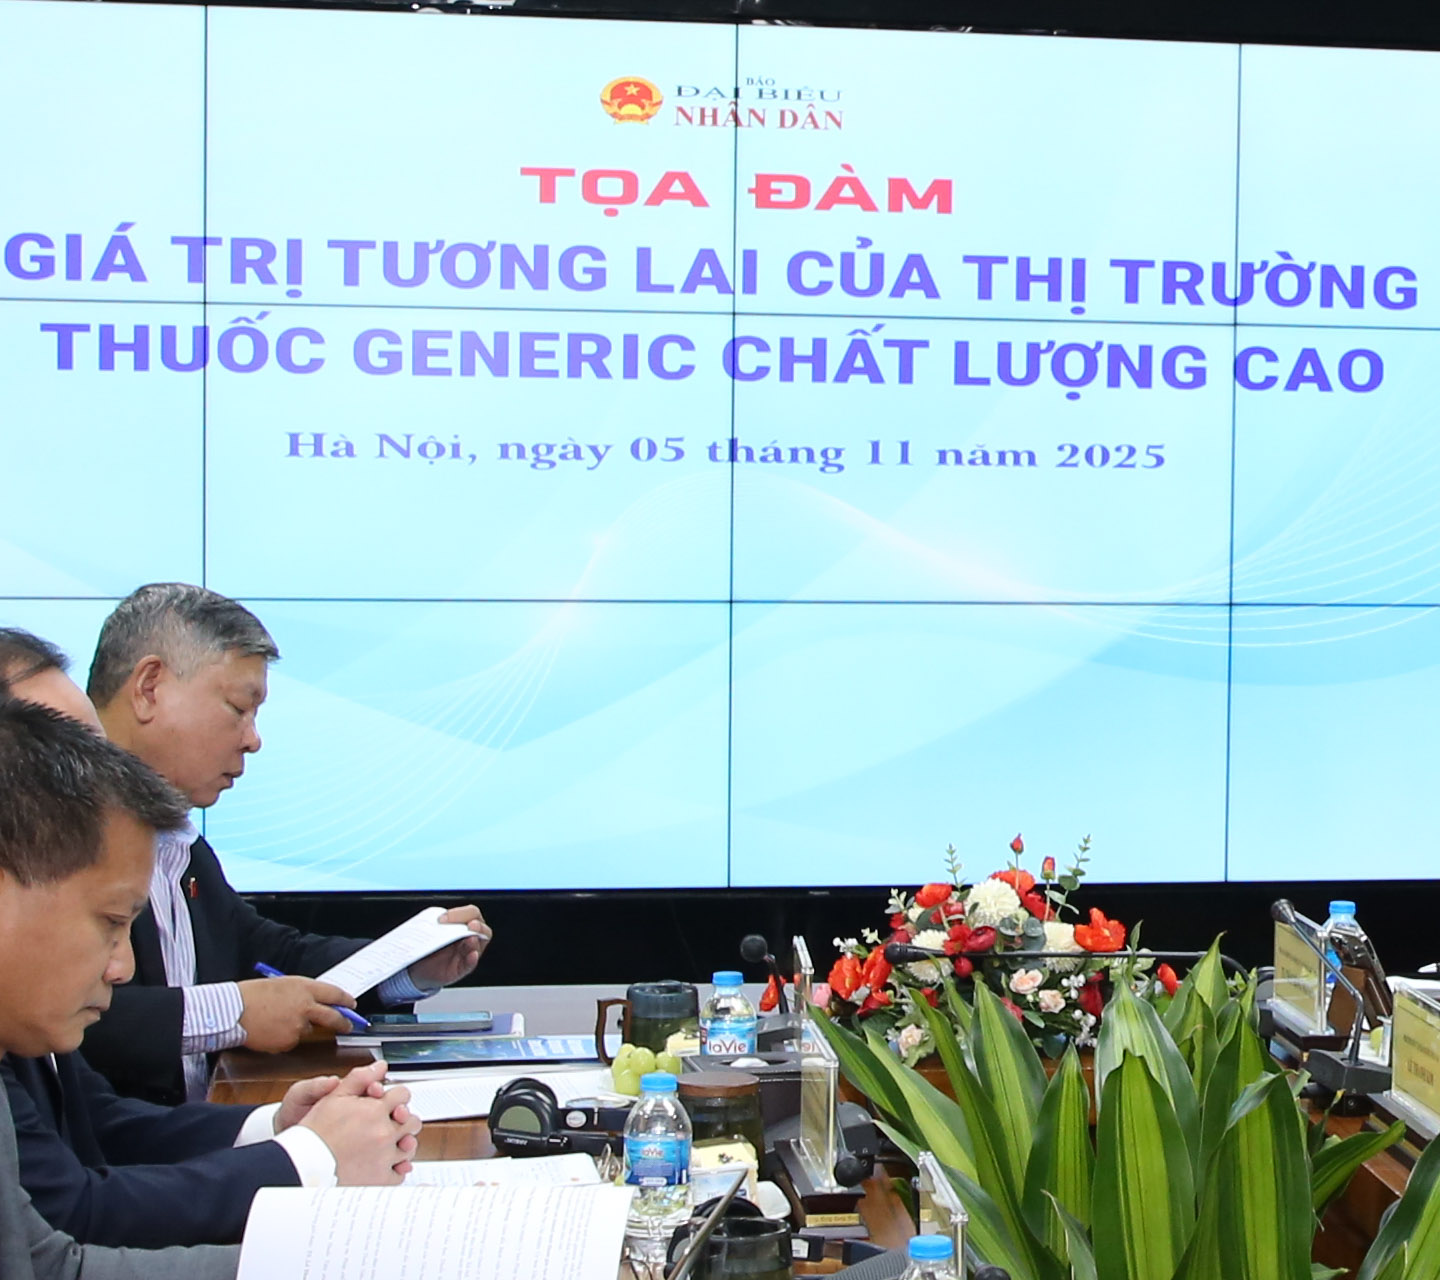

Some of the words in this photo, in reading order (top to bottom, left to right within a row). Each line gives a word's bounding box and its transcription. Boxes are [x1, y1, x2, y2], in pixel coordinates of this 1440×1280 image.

[675, 84, 742, 102] ĐẠI
[673, 101, 767, 128] NHÂN
[777, 103, 844, 131] DÂN
[520, 166, 710, 217] TỌA
[747, 163, 953, 214] ĐÀM
[3, 221, 149, 283] GIÁ
[170, 234, 304, 298] TRỊ
[327, 239, 608, 292] TƯƠNG
[635, 246, 758, 296] LAI
[785, 237, 941, 299] CỦA
[962, 254, 1088, 315] THỊ
[1110, 251, 1419, 310] TRƯỜNG
[39, 311, 326, 374] THUỐC
[352, 328, 697, 381] GENERIC
[721, 323, 930, 385] CHẤT
[953, 339, 1208, 401] LƯỢNG
[1234, 346, 1385, 393] CAO
[284, 431, 356, 460] Hà
[374, 432, 478, 465] Nội,
[497, 435, 613, 470] ngày
[629, 436, 686, 464] 05
[705, 436, 846, 475] tháng
[867, 438, 915, 467] 11
[935, 440, 1038, 468] năm
[1055, 443, 1167, 469] 2025
[709, 1039, 747, 1054] laVie
